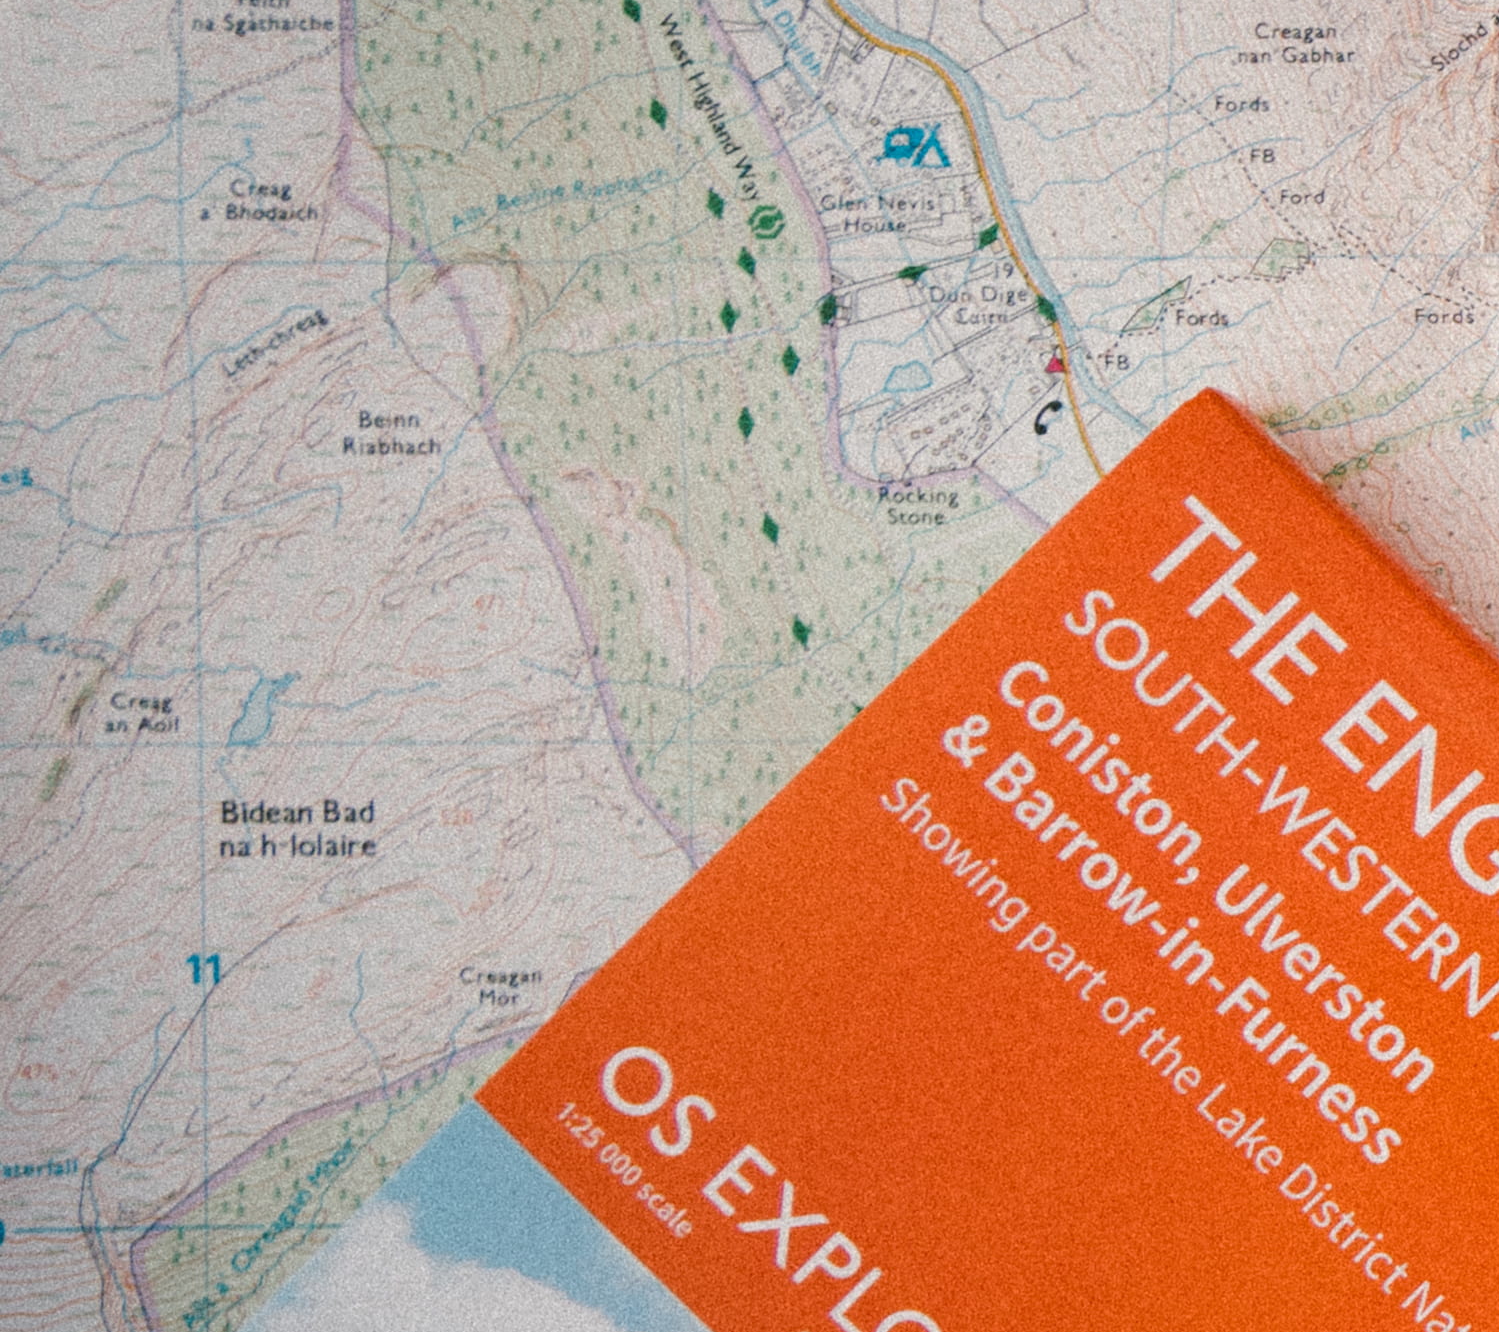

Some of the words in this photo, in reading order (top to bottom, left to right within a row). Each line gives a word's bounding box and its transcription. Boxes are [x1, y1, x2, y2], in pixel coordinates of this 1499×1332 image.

[1150, 495, 1348, 705] THE
[219, 836, 253, 859] na
[220, 800, 312, 828] Bidean
[322, 800, 377, 826] Bad
[1000, 659, 1203, 886] Coniston,
[1216, 859, 1436, 1094] Ulverston
[186, 955, 222, 986] 11
[942, 712, 995, 769] &
[984, 751, 1402, 1167] Barrow-in-Furness
[600, 1045, 717, 1159] OS
[880, 775, 1031, 935] Showing
[1017, 922, 1108, 1006] part
[1100, 990, 1155, 1039] of
[1139, 1023, 1205, 1097] the
[1200, 1083, 1286, 1176] Lake
[1280, 1162, 1409, 1295] District
